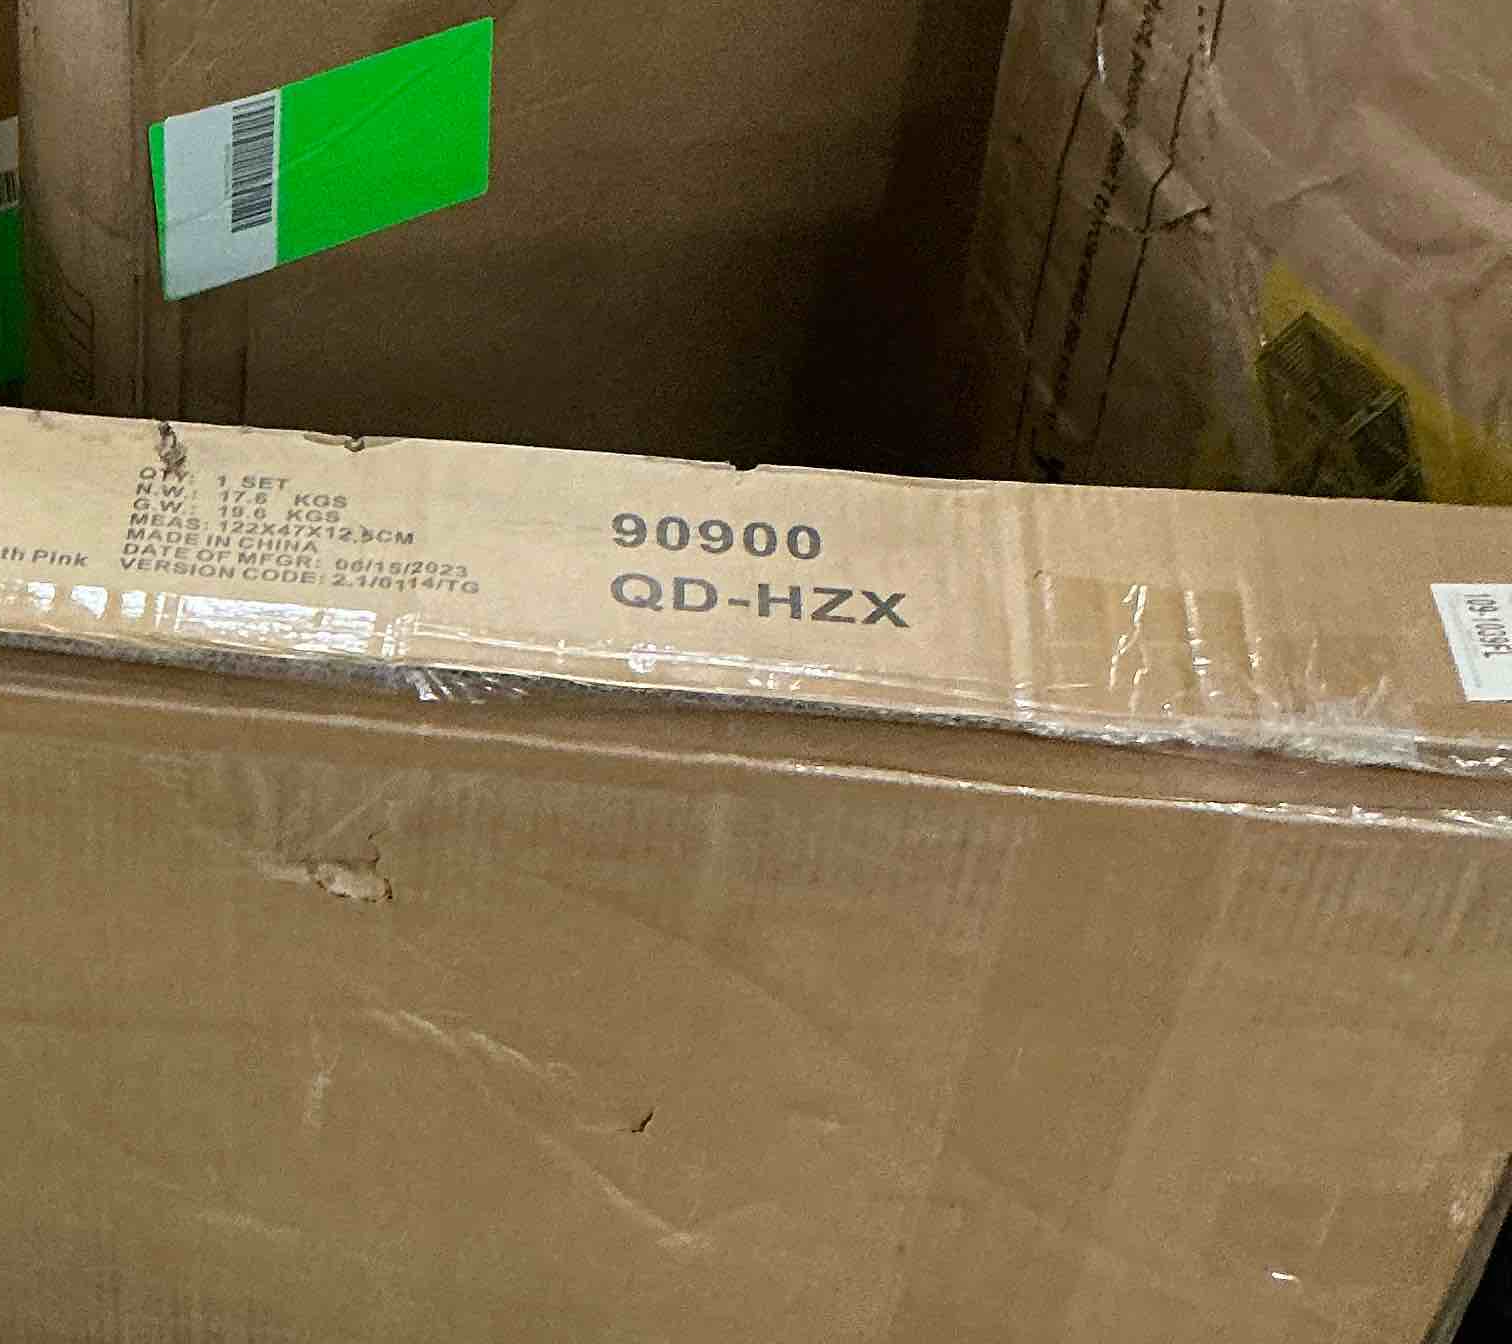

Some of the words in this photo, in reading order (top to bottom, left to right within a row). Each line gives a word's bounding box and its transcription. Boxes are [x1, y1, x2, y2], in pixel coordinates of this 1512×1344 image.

[240, 475, 290, 492] SET
[292, 492, 349, 509] KGS
[128, 512, 209, 532] MEAS:
[285, 508, 342, 524] KGS
[125, 527, 202, 547] MADE
[206, 534, 231, 549] IN
[237, 536, 319, 555] CHINA
[611, 512, 823, 560] 90900
[30, 549, 89, 568] Pink
[122, 542, 193, 559] DATE
[195, 547, 234, 563] OF
[237, 550, 322, 570] MFGR:
[118, 557, 237, 579] VERSION
[241, 566, 325, 586] CODE:
[610, 572, 910, 629] QD-HZX
